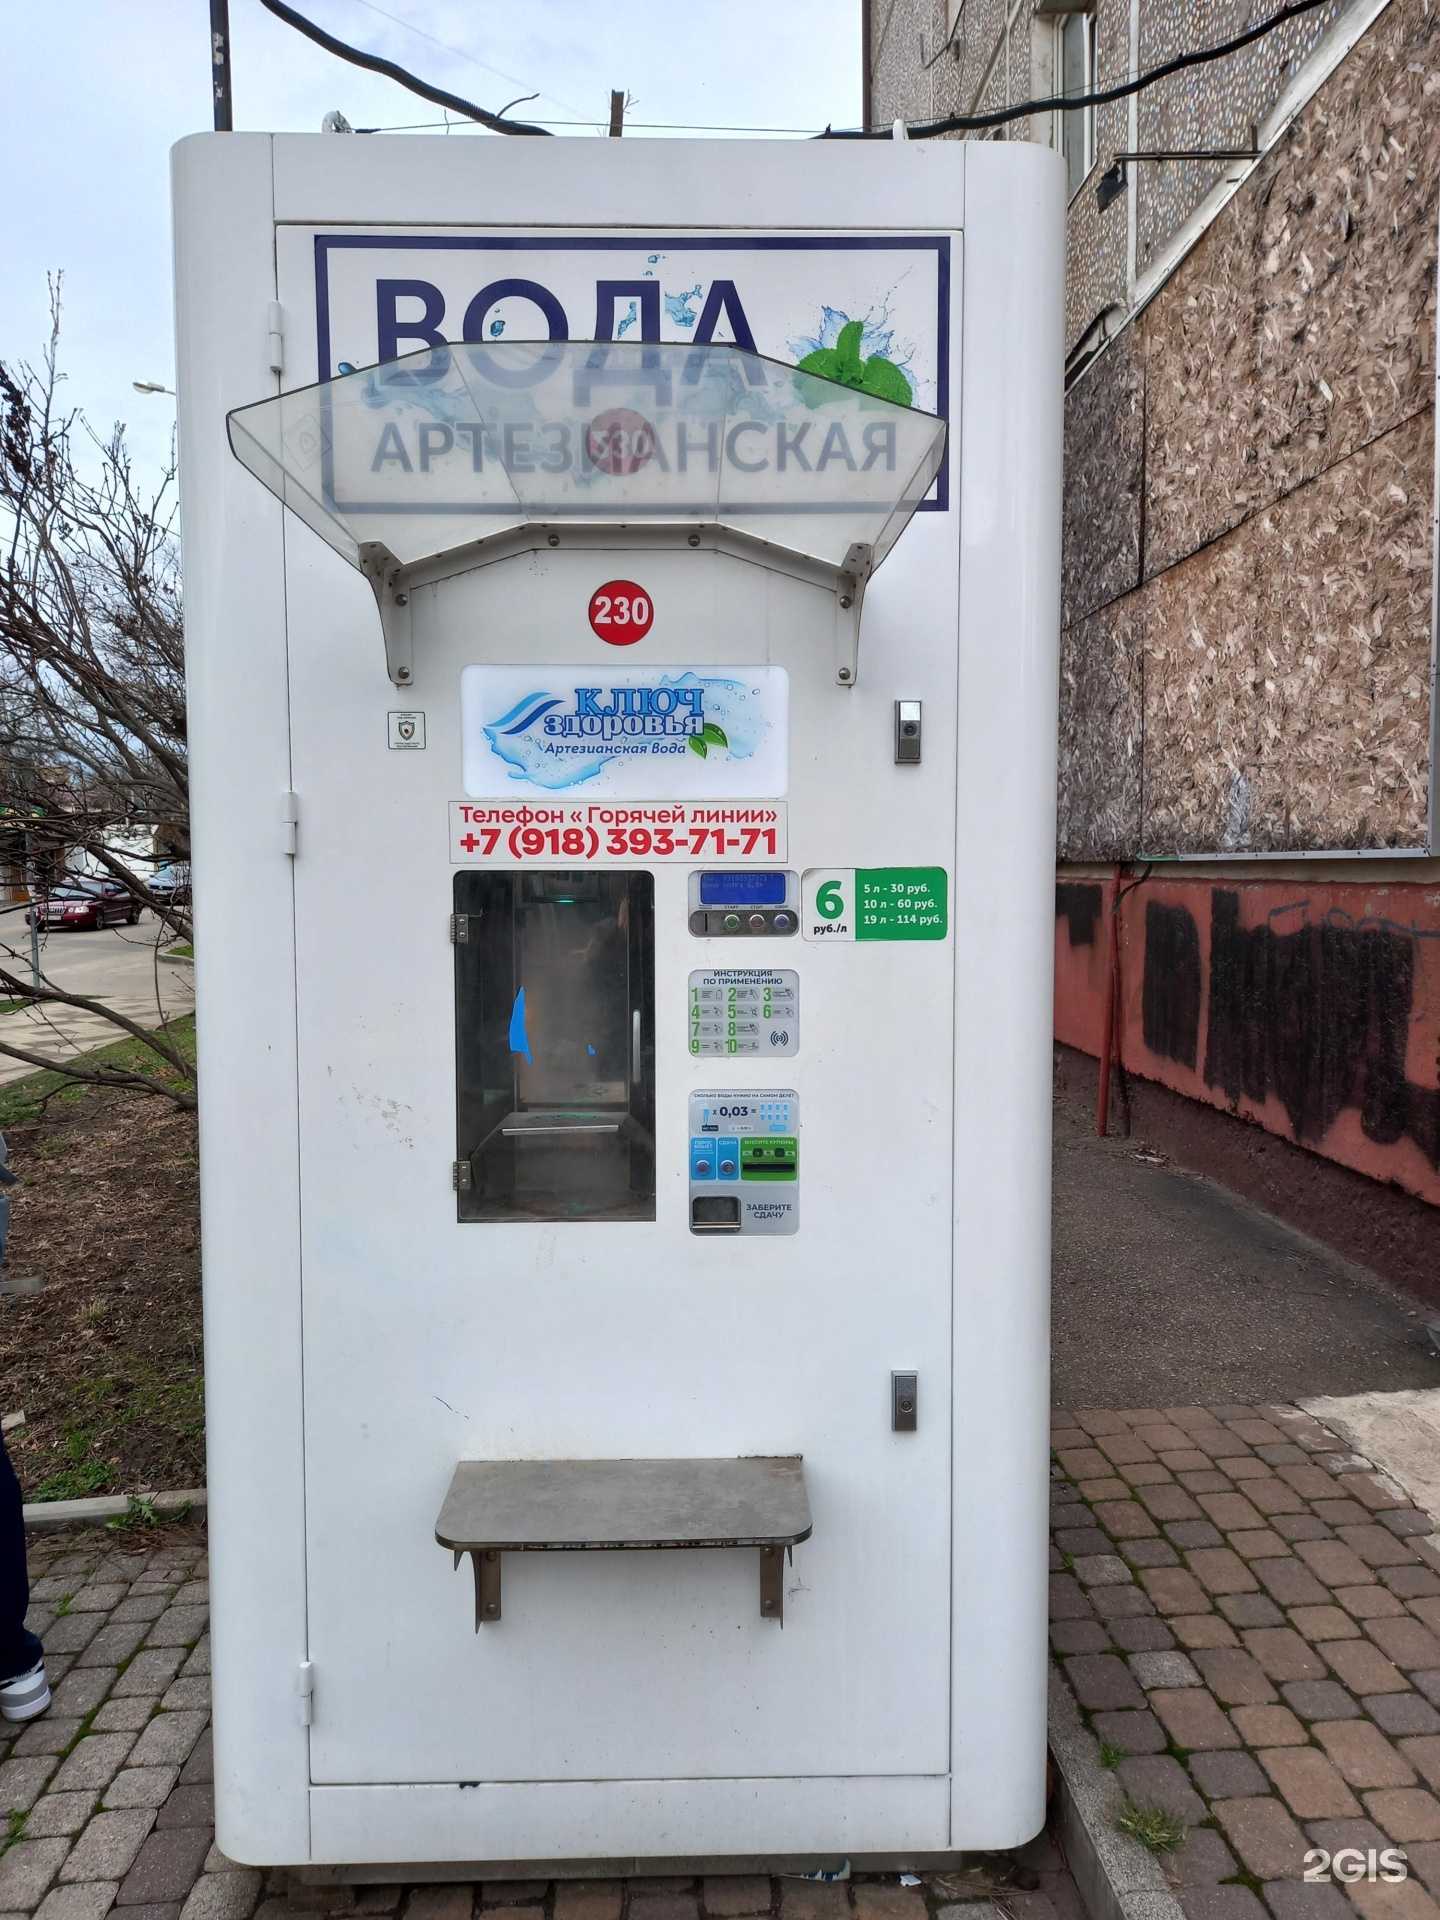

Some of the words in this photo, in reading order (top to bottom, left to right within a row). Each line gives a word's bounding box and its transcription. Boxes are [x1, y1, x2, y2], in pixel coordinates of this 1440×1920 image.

[375, 279, 768, 408] ВОДА
[370, 420, 898, 474] АРТЕЗИАНСКАЯ
[594, 597, 650, 627] 230
[574, 688, 704, 716] КЛЮЧ
[544, 742, 648, 757] Артезианская
[459, 806, 564, 827] Телефон
[690, 808, 777, 824] линии»
[460, 828, 501, 855] +7
[508, 826, 599, 859] (918)
[606, 828, 777, 856] 393-71-71
[863, 884, 871, 893] 5
[890, 883, 904, 893] 30
[907, 883, 931, 895] руб.
[816, 880, 844, 919] 6
[863, 899, 877, 909] 10
[880, 901, 887, 909] л
[897, 899, 911, 909] 60
[914, 899, 938, 911] руб.
[863, 915, 877, 925] 19
[880, 917, 887, 925] л
[897, 915, 916, 924] 114
[919, 914, 943, 926] руб.
[813, 924, 848, 936] руб./л
[713, 969, 773, 978] ИНСТРУКЦИЯ
[718, 977, 783, 985] ПРИМЕНЕНИЮ
[691, 987, 698, 1002] 1
[728, 987, 737, 1002] 2
[763, 987, 772, 1002] 3
[691, 1004, 700, 1019] 4
[728, 1004, 736, 1019] 5
[763, 1004, 772, 1019] 6
[691, 1021, 700, 1036] 7
[728, 1021, 736, 1036] 8
[691, 1039, 700, 1054] 9
[725, 1039, 737, 1054] 10
[719, 1106, 749, 1118] 0,03
[746, 1203, 793, 1211] ЗАБЕРИТЕ
[753, 1211, 785, 1219] СДАЧУ
